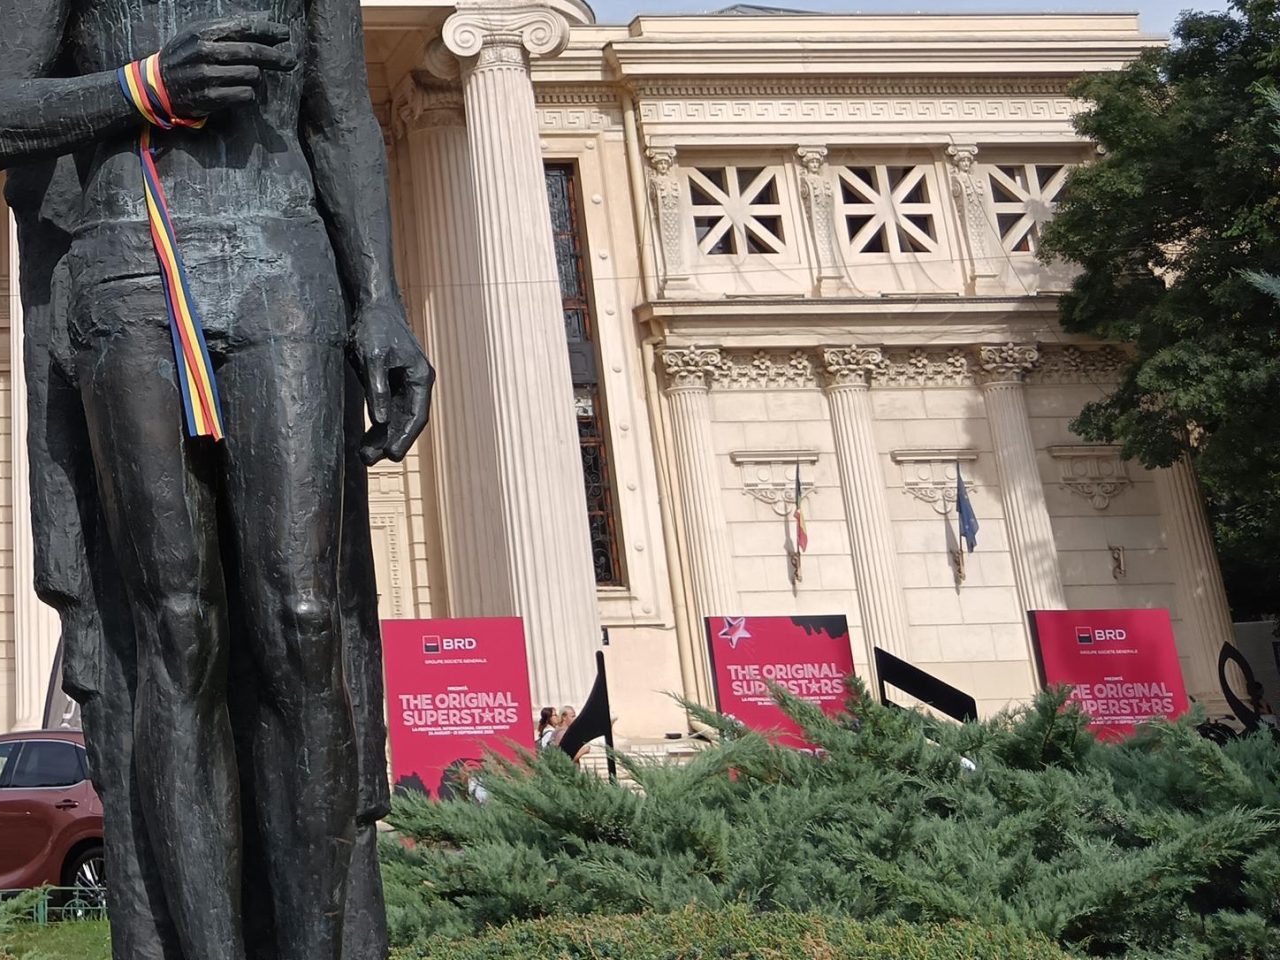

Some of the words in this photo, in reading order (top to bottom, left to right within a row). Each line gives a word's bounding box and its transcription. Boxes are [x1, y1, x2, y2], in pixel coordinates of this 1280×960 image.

[1095, 629, 1126, 641] BRD
[442, 638, 477, 650] BRD
[727, 665, 761, 680] THE
[762, 663, 844, 679] ORIGINAL
[1066, 684, 1092, 699] HE
[1094, 682, 1173, 698] ORIGINAL
[399, 694, 433, 710] THE
[435, 692, 518, 709] ORIGINAL
